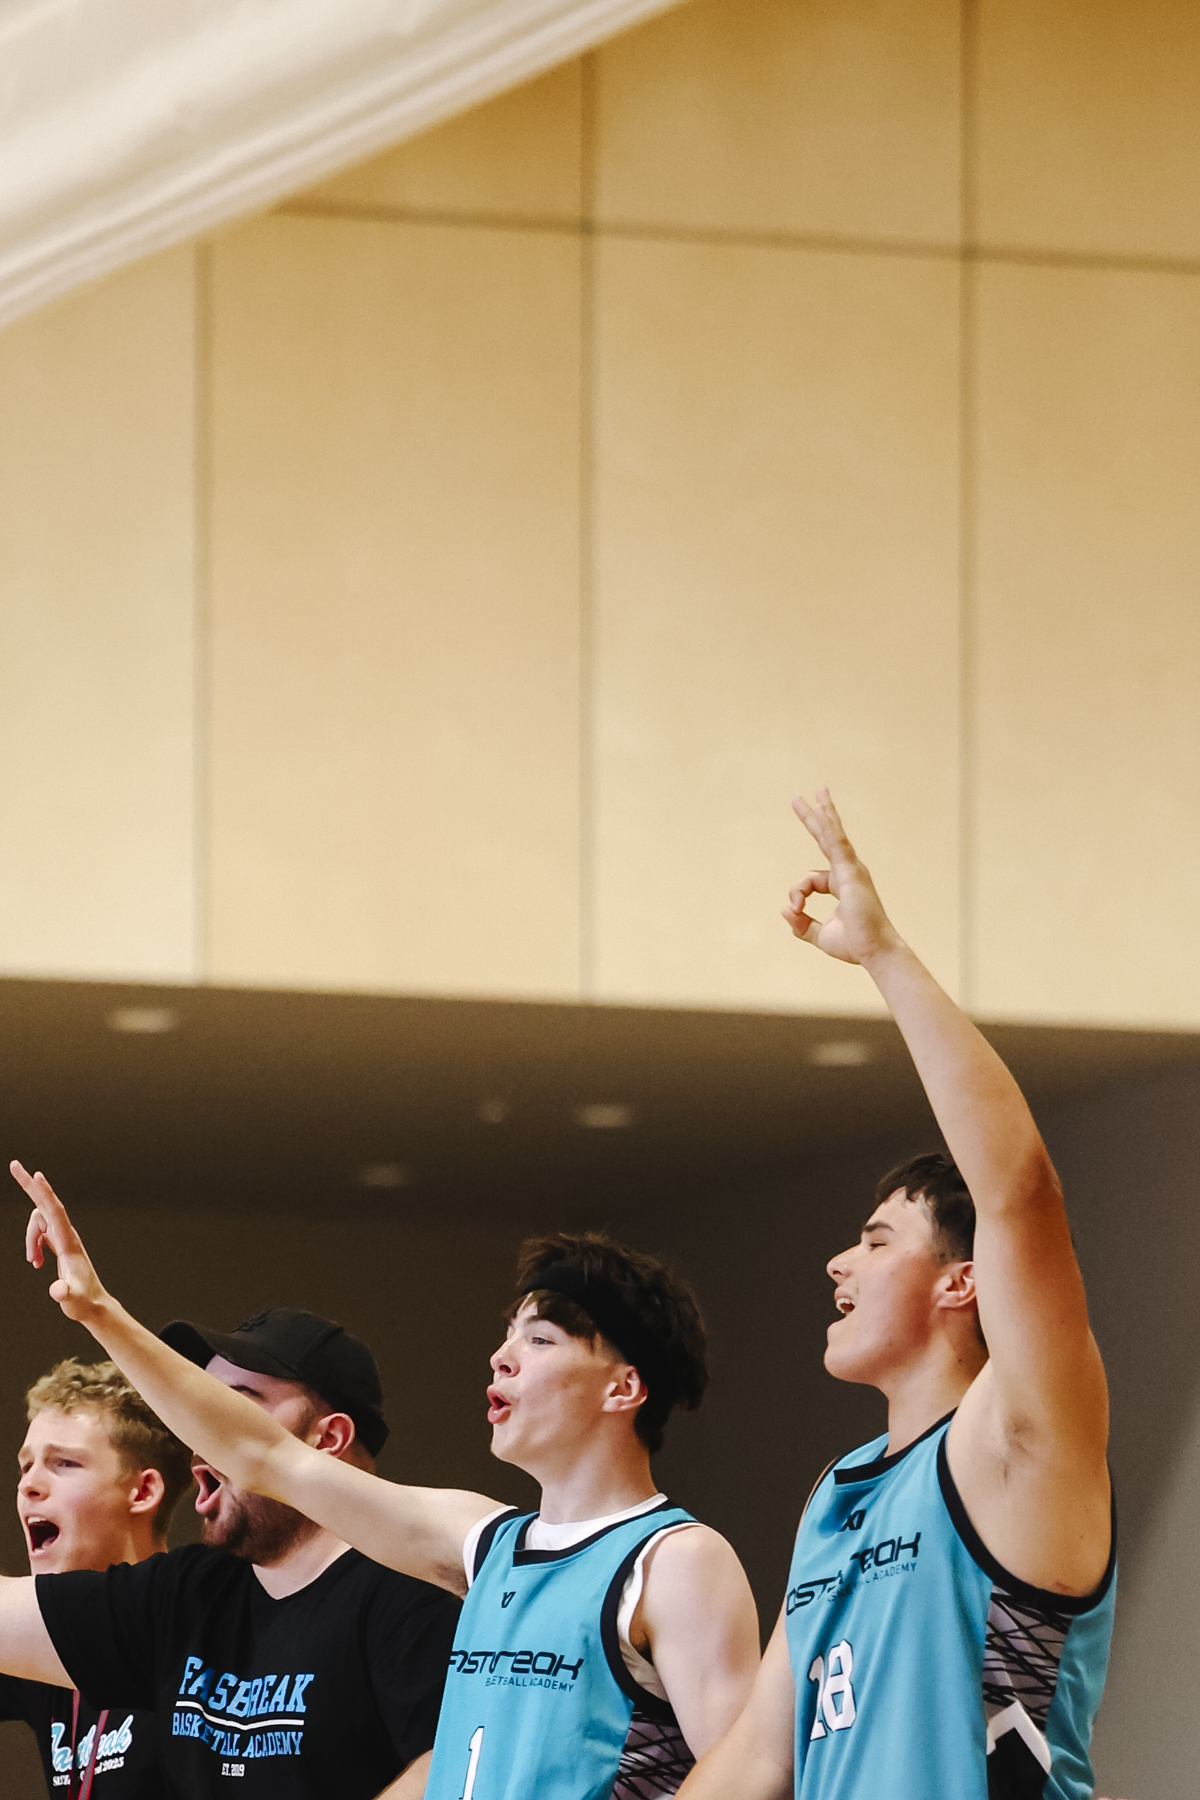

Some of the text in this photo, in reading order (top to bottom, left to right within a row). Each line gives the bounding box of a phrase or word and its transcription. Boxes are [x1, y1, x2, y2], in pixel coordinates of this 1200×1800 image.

[177, 1655, 316, 1719] FASBREAK
[807, 1638, 857, 1741] 18
[171, 1711, 304, 1759] BASKETALL ACADEMY
